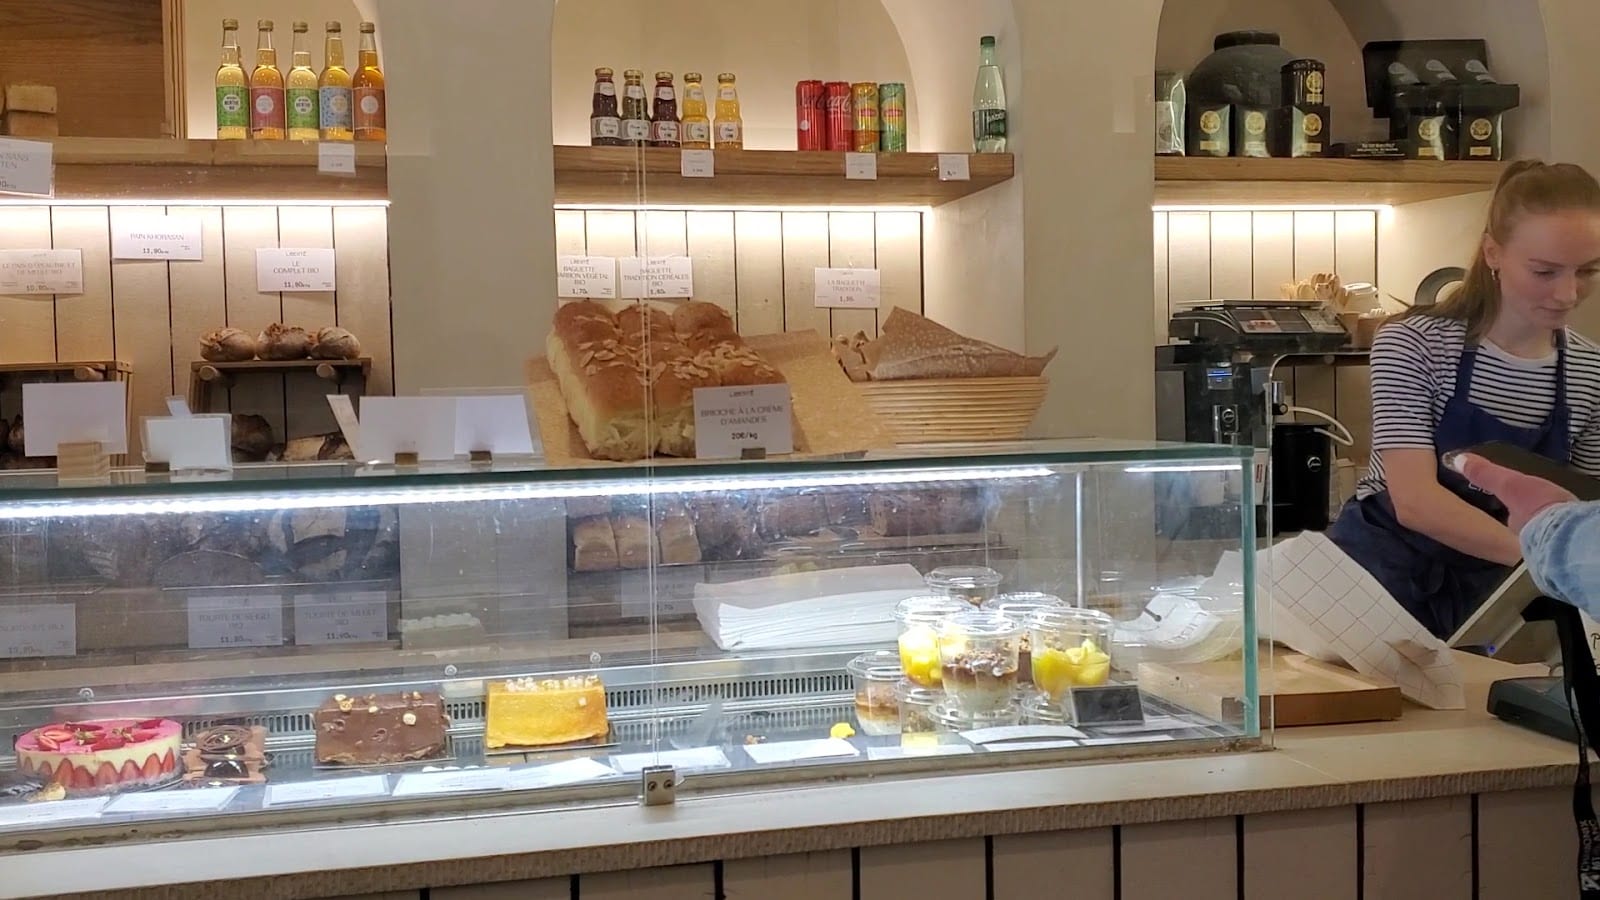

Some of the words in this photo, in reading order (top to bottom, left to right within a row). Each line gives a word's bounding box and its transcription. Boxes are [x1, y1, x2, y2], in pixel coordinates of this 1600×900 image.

[273, 266, 305, 274] COMPLET
[563, 265, 594, 273] BAGUETTE
[624, 273, 657, 281] TRADITION
[701, 407, 737, 417] BRIOCHE
